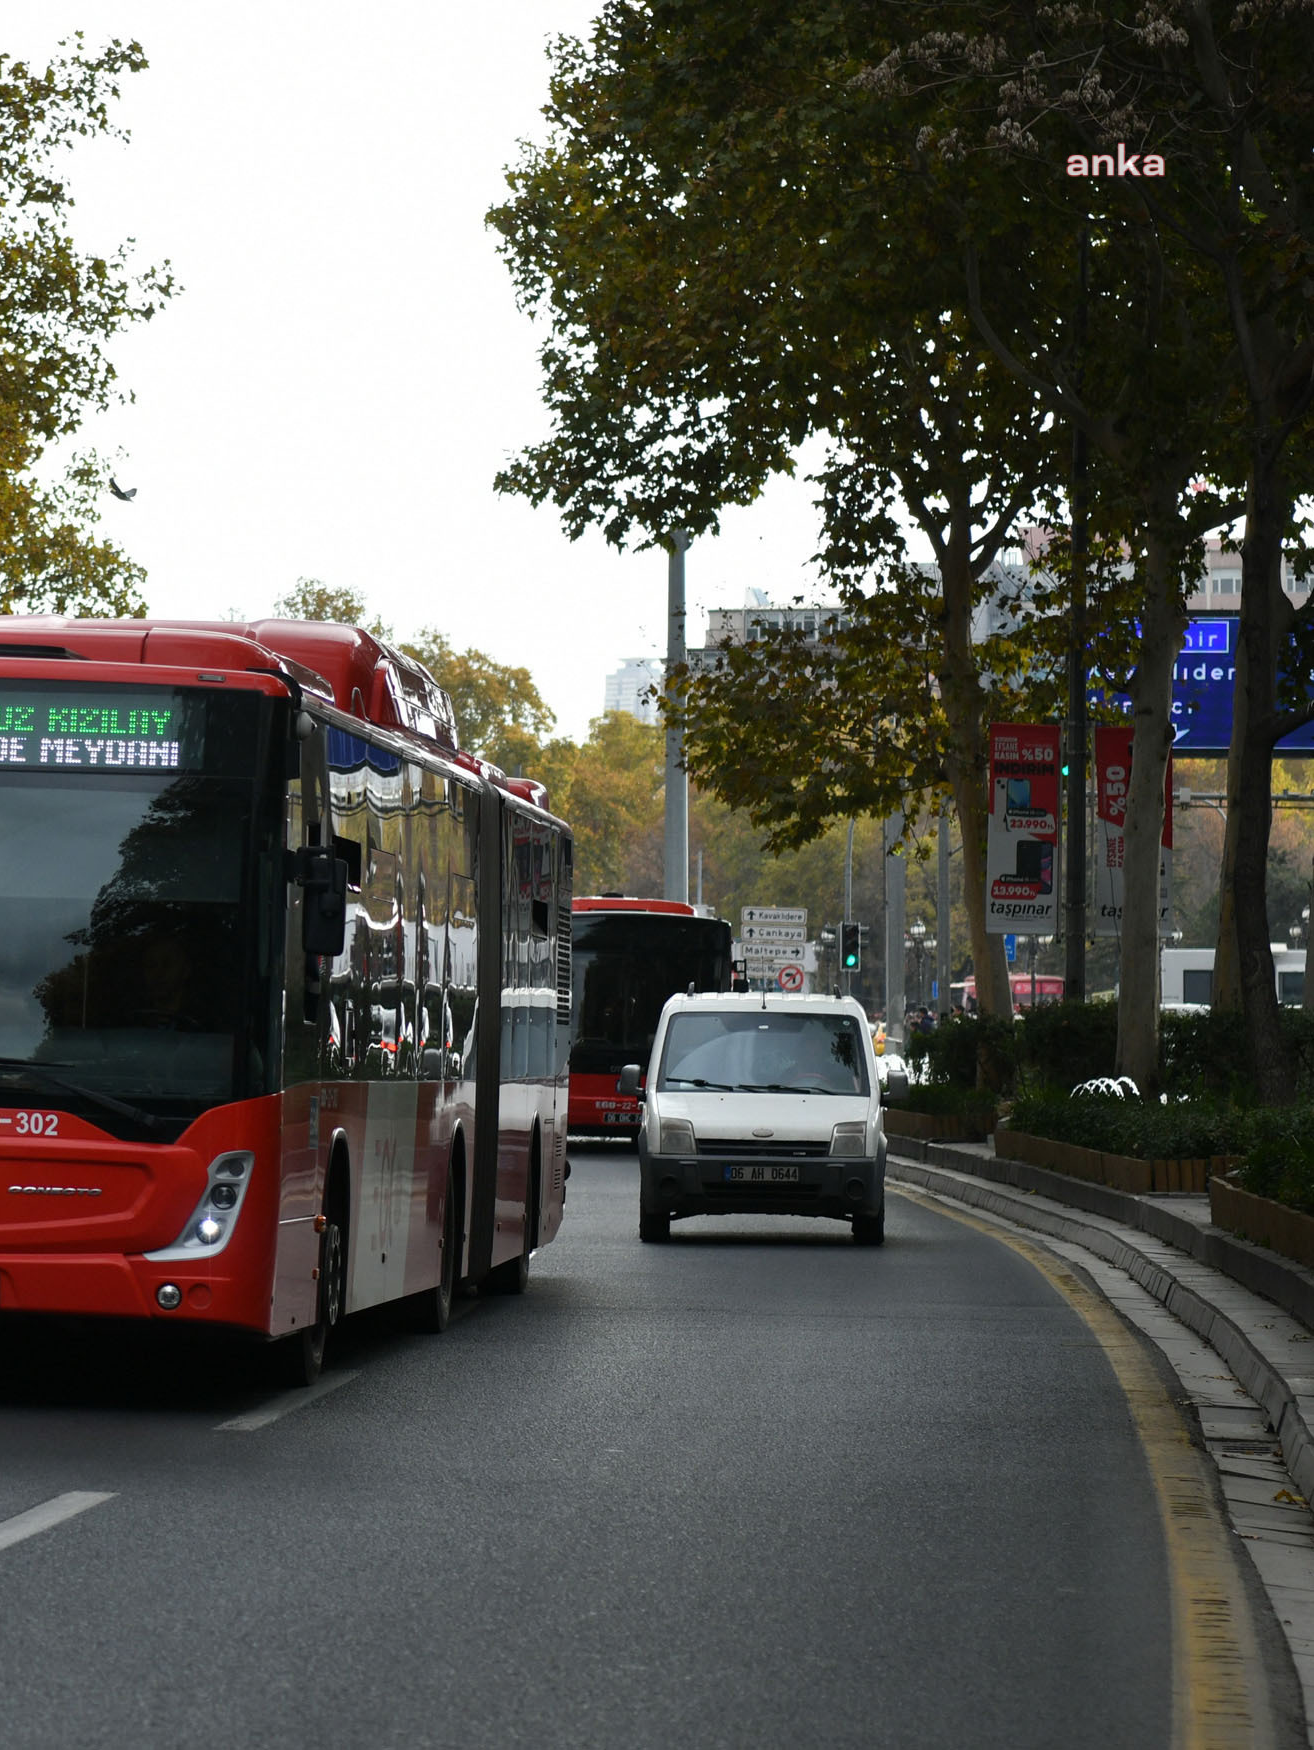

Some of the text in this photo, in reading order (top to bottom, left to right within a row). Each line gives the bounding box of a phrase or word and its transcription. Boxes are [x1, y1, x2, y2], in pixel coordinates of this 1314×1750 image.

[47, 707, 173, 735] KIZILAY
[39, 737, 181, 767] MEYDANI
[1021, 747, 1055, 761] %50
[1106, 765, 1127, 818] %50
[990, 901, 1053, 918] taşpınar
[758, 928, 802, 939] Çankaya
[745, 946, 788, 957] Maltepe
[731, 1168, 744, 1179] 06
[771, 1168, 798, 1180] 0644
[8, 1185, 103, 1197] CONECTO
